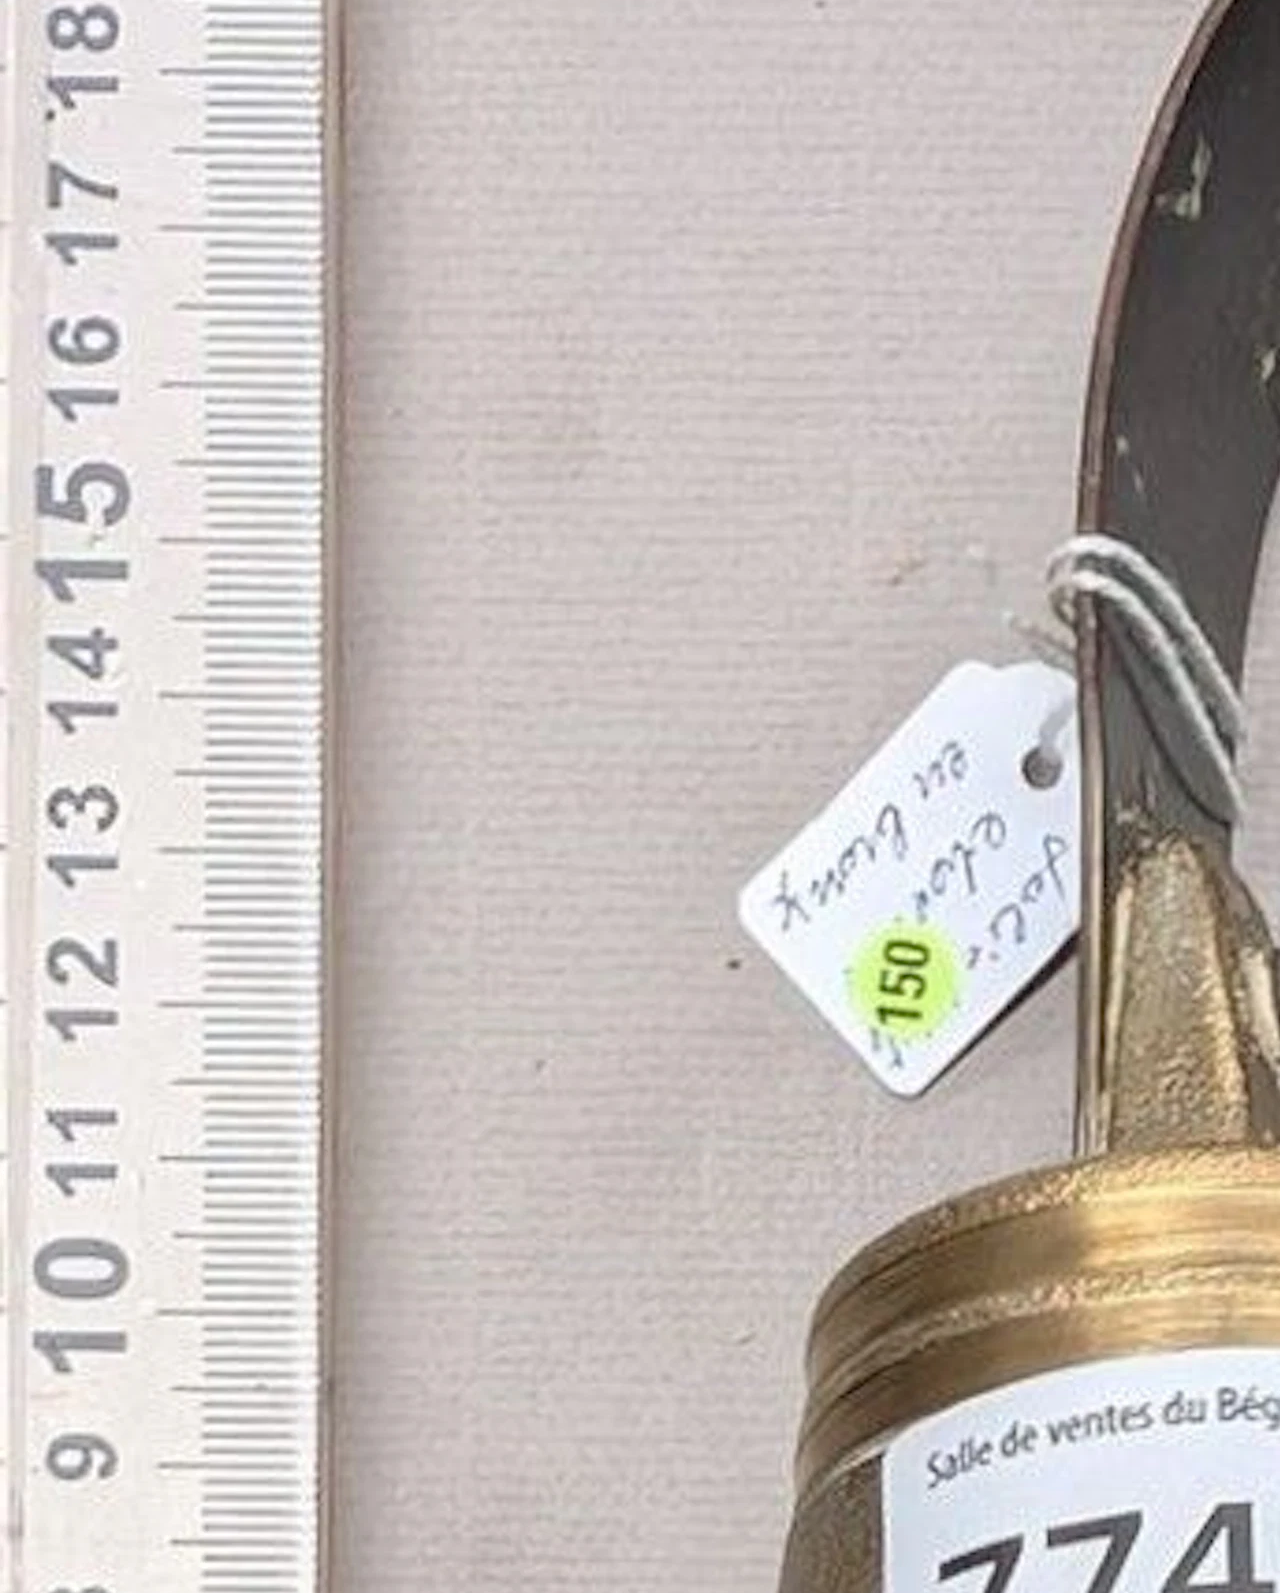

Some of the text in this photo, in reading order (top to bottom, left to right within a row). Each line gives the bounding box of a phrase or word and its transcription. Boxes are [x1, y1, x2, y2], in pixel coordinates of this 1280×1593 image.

[44, 3, 121, 111] 18
[43, 161, 121, 267] 17
[45, 315, 122, 424] 16
[32, 461, 132, 604] 15
[45, 626, 120, 736] 14
[45, 784, 121, 890] 13
[44, 937, 120, 1044] 12
[874, 938, 932, 1025] 150
[44, 1108, 120, 1199] 11
[31, 1237, 131, 1375] 10
[44, 1432, 120, 1482] 9
[925, 1435, 994, 1491] Salle
[999, 1420, 1039, 1460] de
[1045, 1401, 1155, 1447] ventes
[1161, 1389, 1208, 1427] du
